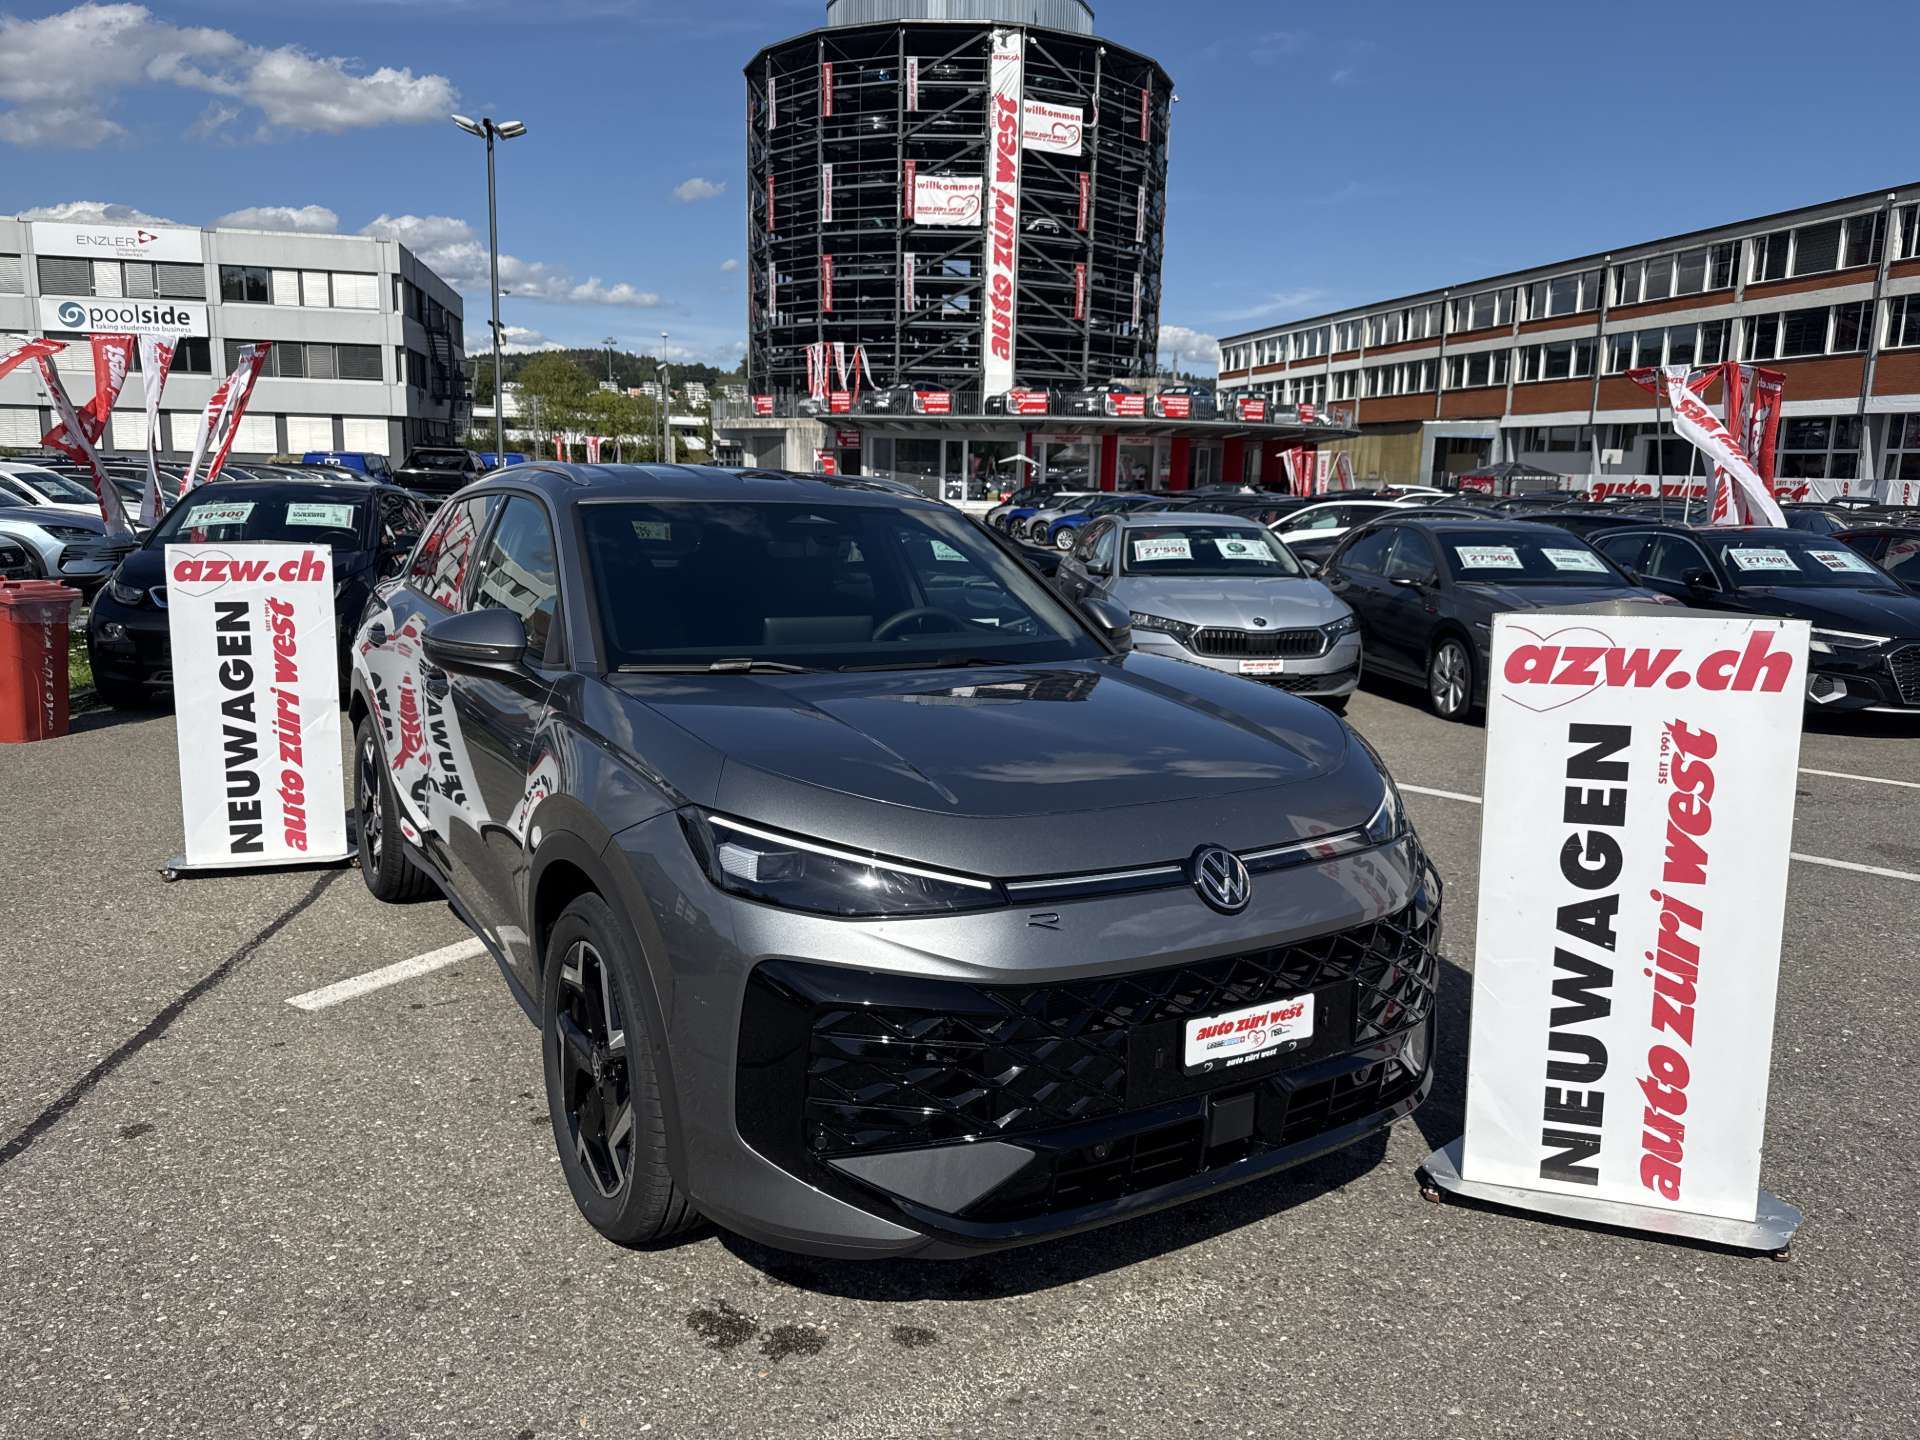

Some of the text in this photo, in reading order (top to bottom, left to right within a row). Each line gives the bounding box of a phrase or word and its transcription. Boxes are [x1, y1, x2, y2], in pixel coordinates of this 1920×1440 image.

[1025, 105, 1081, 121] willkommen
[917, 180, 980, 191] willkommen
[989, 91, 1018, 361] auto züri west
[76, 234, 137, 248] ENZLER
[89, 304, 191, 329] poolside
[96, 323, 119, 332] taking
[120, 324, 151, 332] students
[161, 325, 192, 334] business
[107, 344, 126, 390] west
[1591, 477, 1653, 502] auto
[197, 510, 245, 520] 10'400
[1144, 546, 1186, 555] 27'550
[1744, 556, 1789, 565] 27'400
[173, 550, 326, 582] azw.ch
[1503, 630, 1794, 694] azw.ch
[214, 601, 264, 854] NEUWAGEN
[264, 596, 308, 852] auto züri west
[1658, 730, 1672, 785] SEIT 1991
[1539, 722, 1633, 1186] NEUWAGEN
[1635, 718, 1718, 1203] auto züri west
[1195, 1019, 1235, 1041] auto
[1234, 1010, 1270, 1033] züri
[1270, 1002, 1305, 1025] west
[1225, 1056, 1244, 1067] auto
[1260, 1048, 1278, 1060] west
